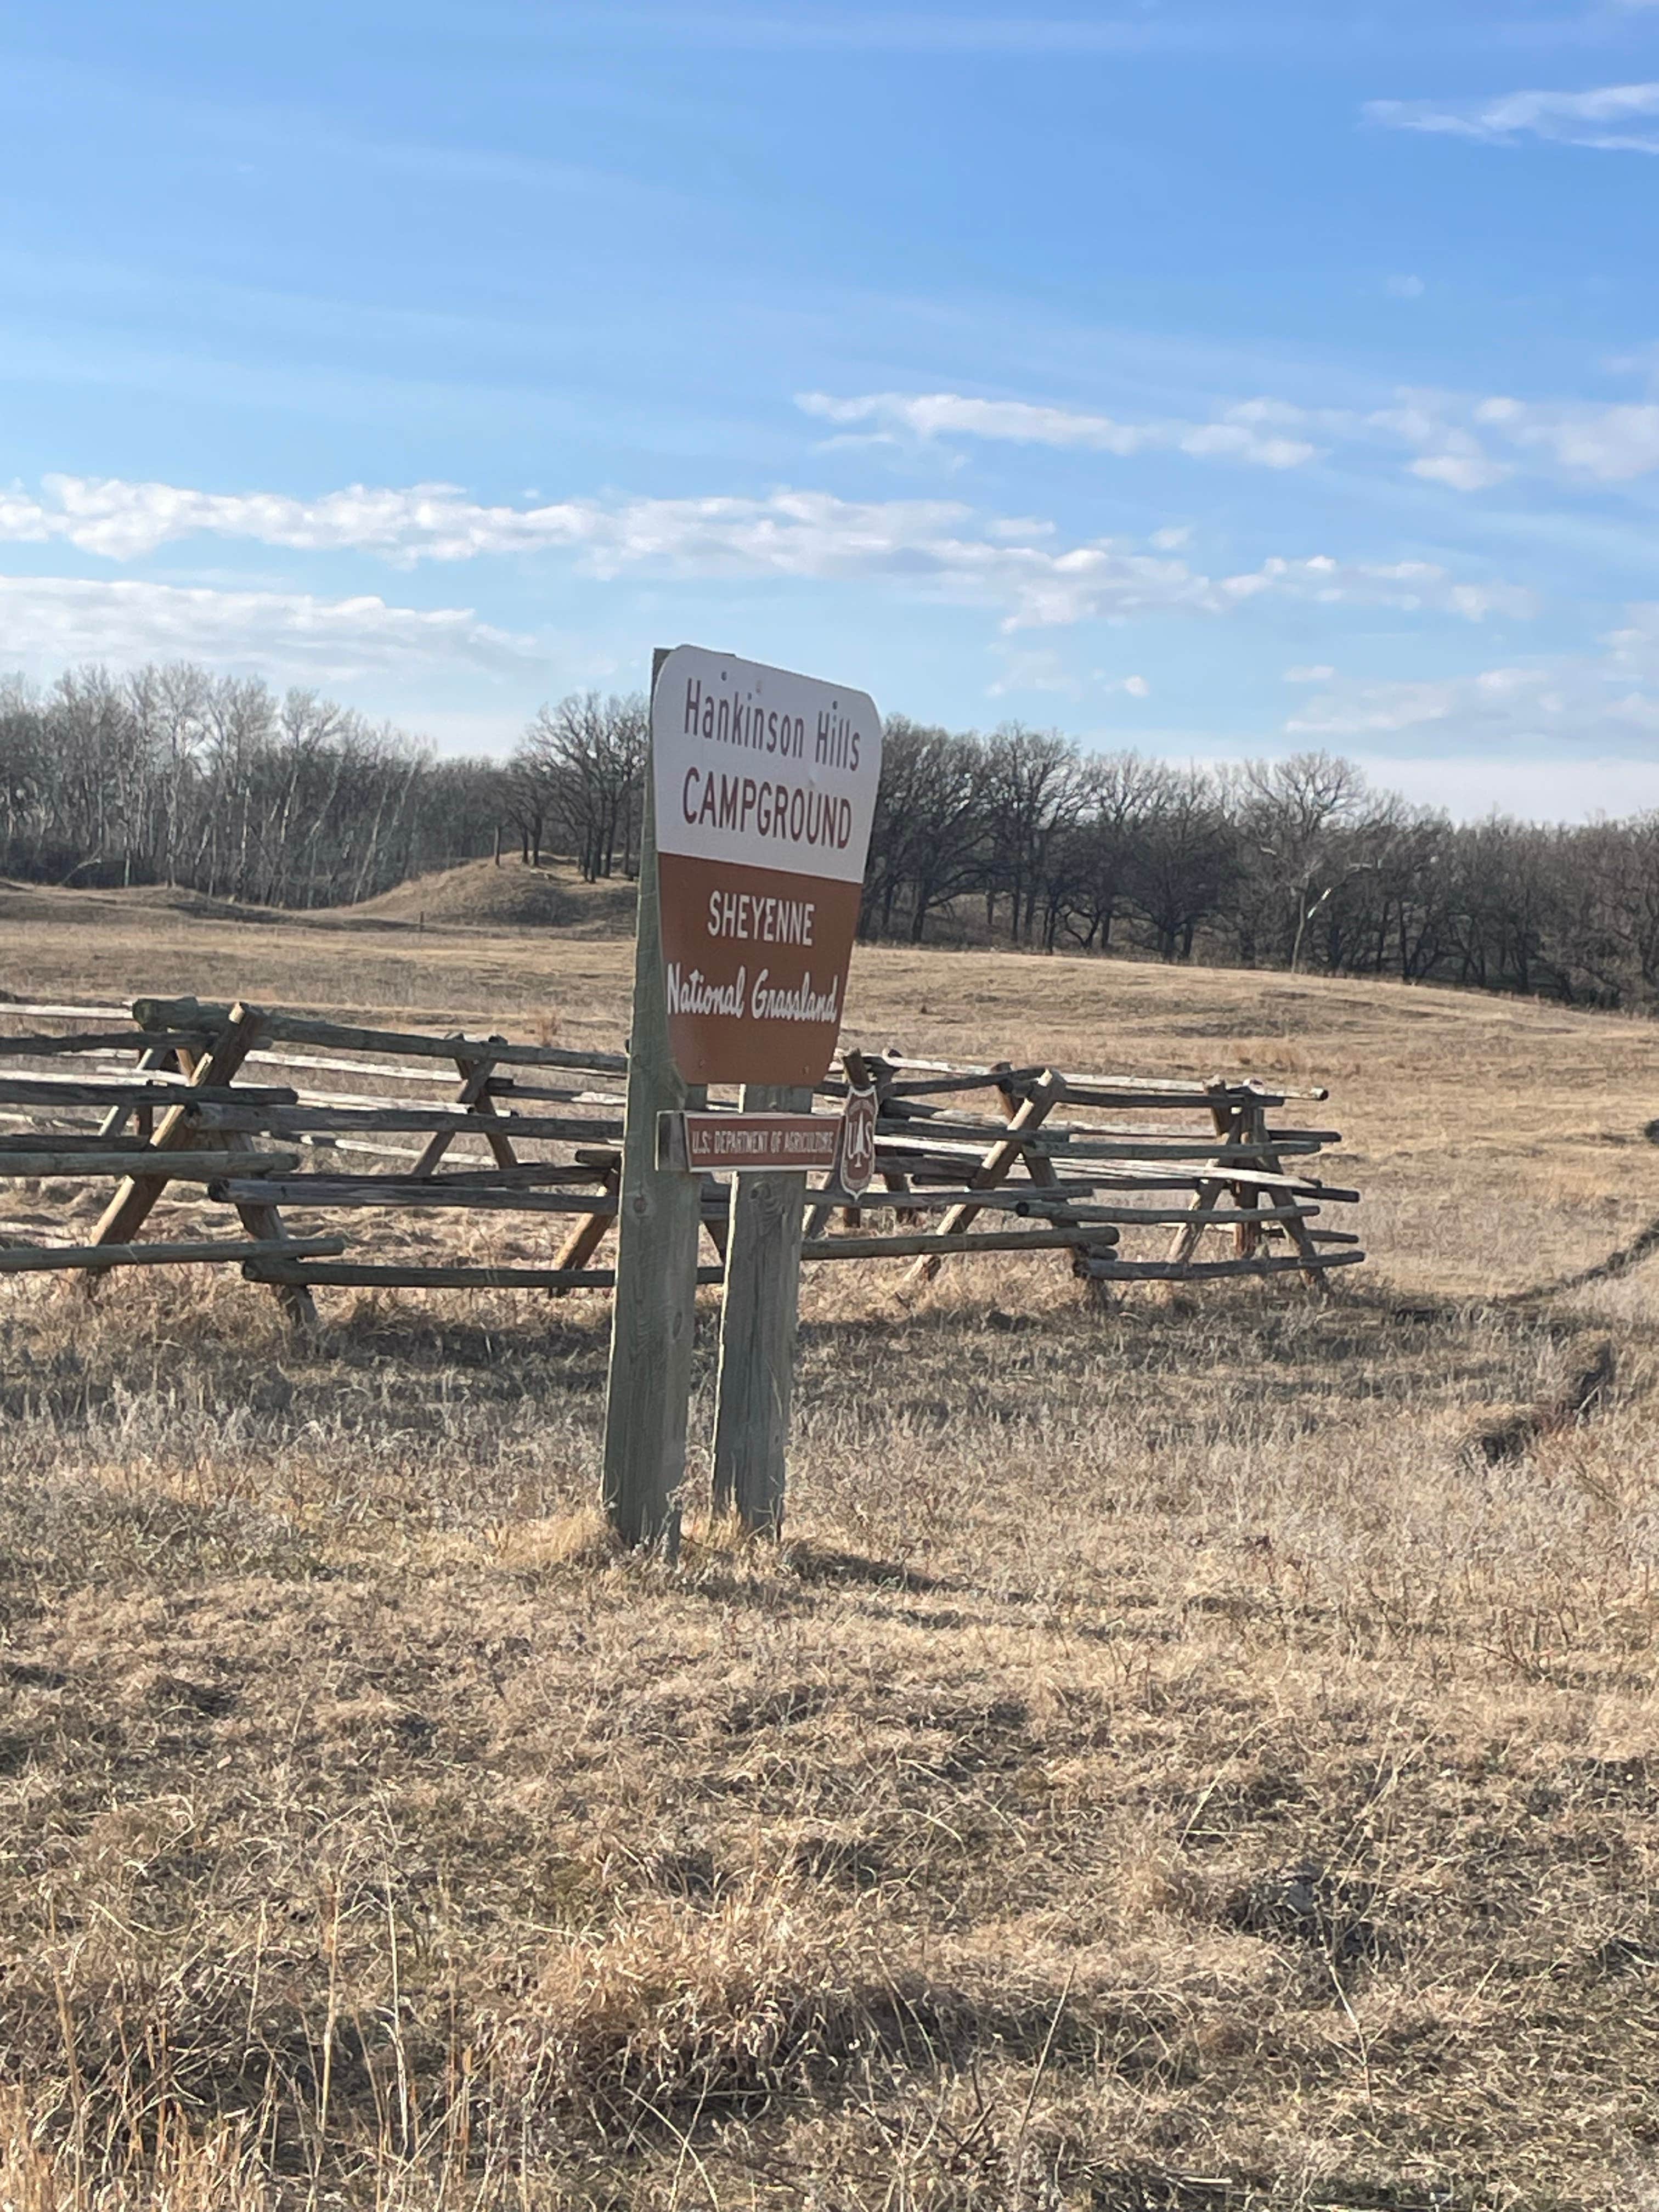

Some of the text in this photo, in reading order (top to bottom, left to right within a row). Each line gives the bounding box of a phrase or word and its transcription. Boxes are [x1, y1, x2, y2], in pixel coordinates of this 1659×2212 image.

[684, 678, 860, 771] Hankinson Hills
[683, 766, 851, 849] CAMPGROUND
[708, 890, 815, 946] SHEYENNE
[667, 962, 839, 1023] National Grassland
[714, 1130, 769, 1154] DEPARTMENT
[771, 1130, 783, 1154] OF
